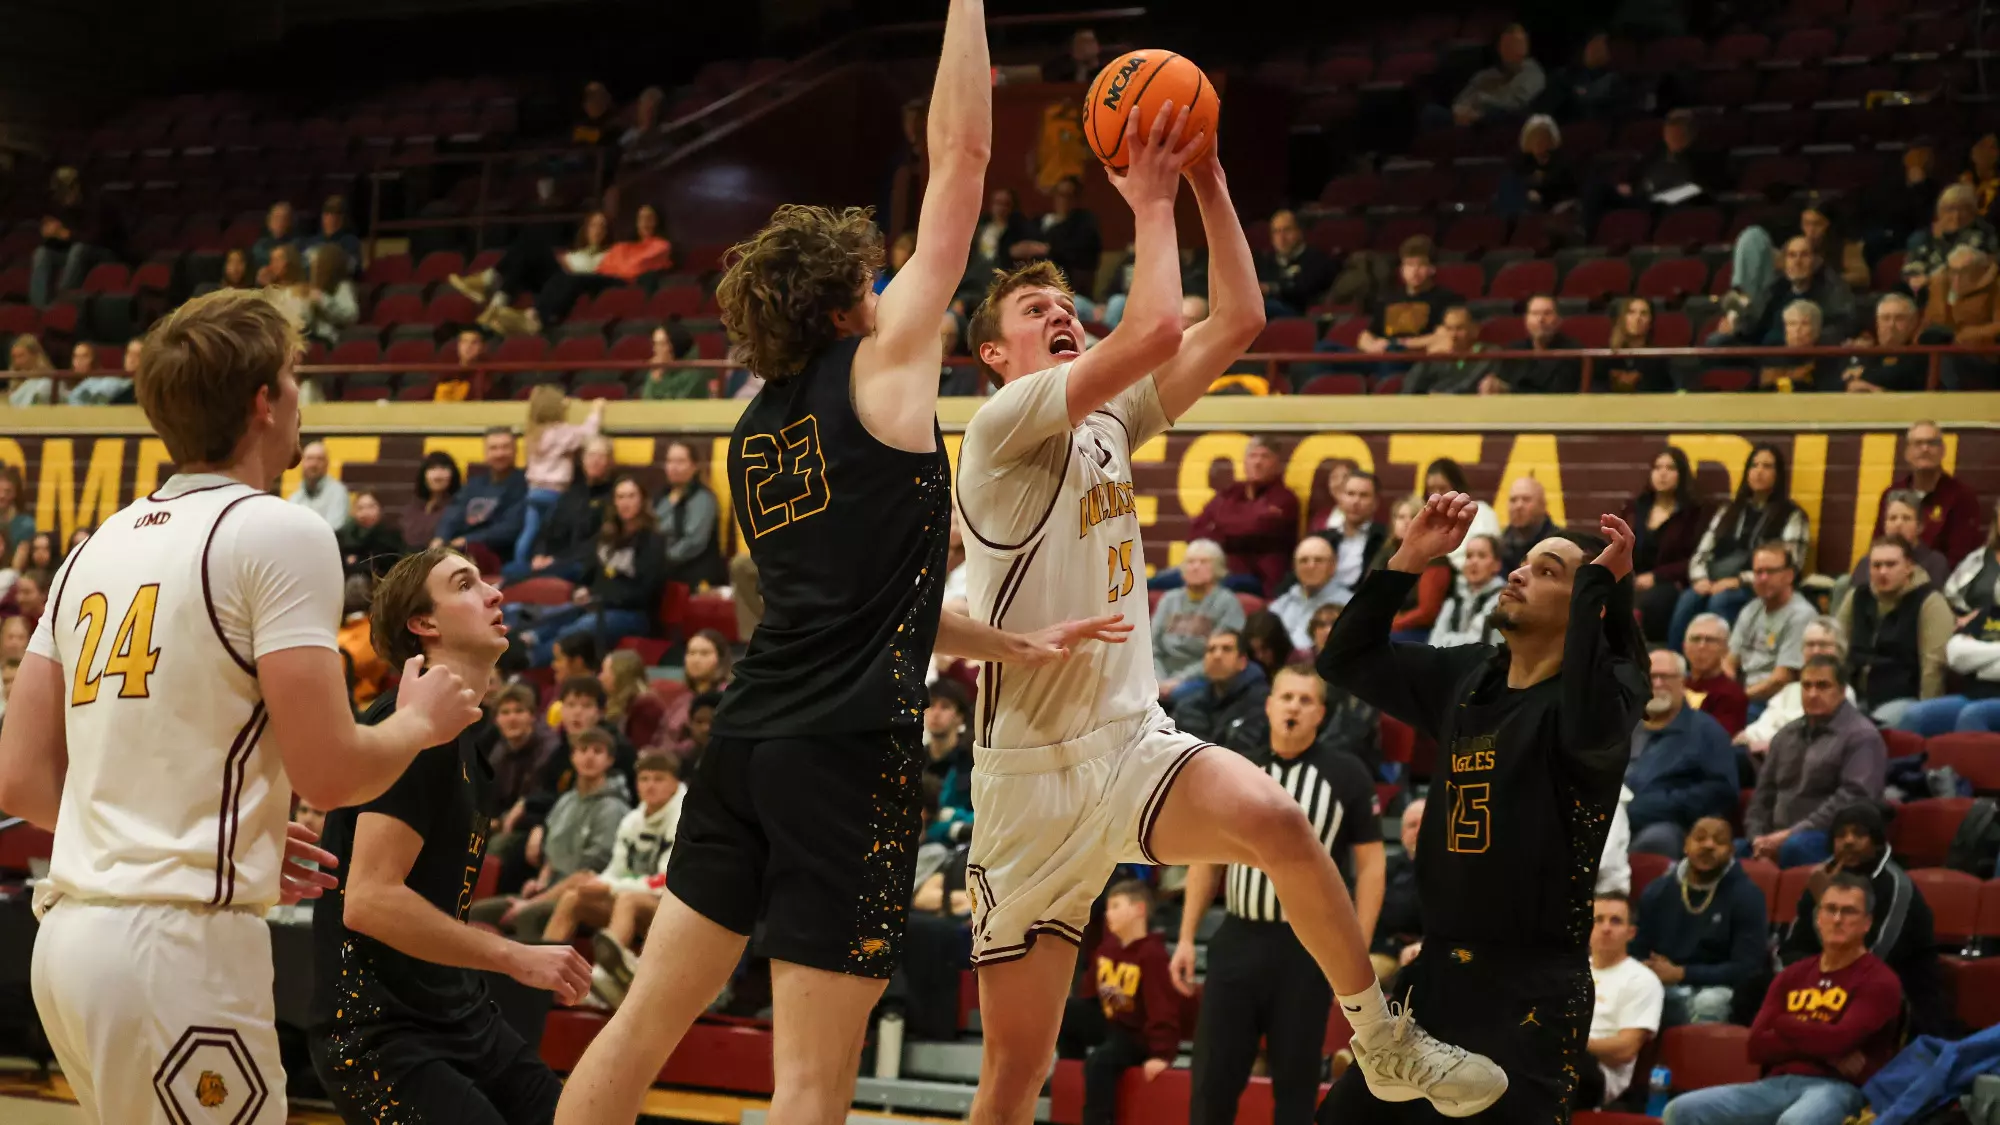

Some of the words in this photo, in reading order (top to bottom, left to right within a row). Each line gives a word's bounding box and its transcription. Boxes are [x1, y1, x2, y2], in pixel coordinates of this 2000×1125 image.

[1103, 57, 1147, 112] NCAA
[133, 511, 172, 529] UMD
[741, 413, 831, 539] 23
[71, 582, 162, 708] 24
